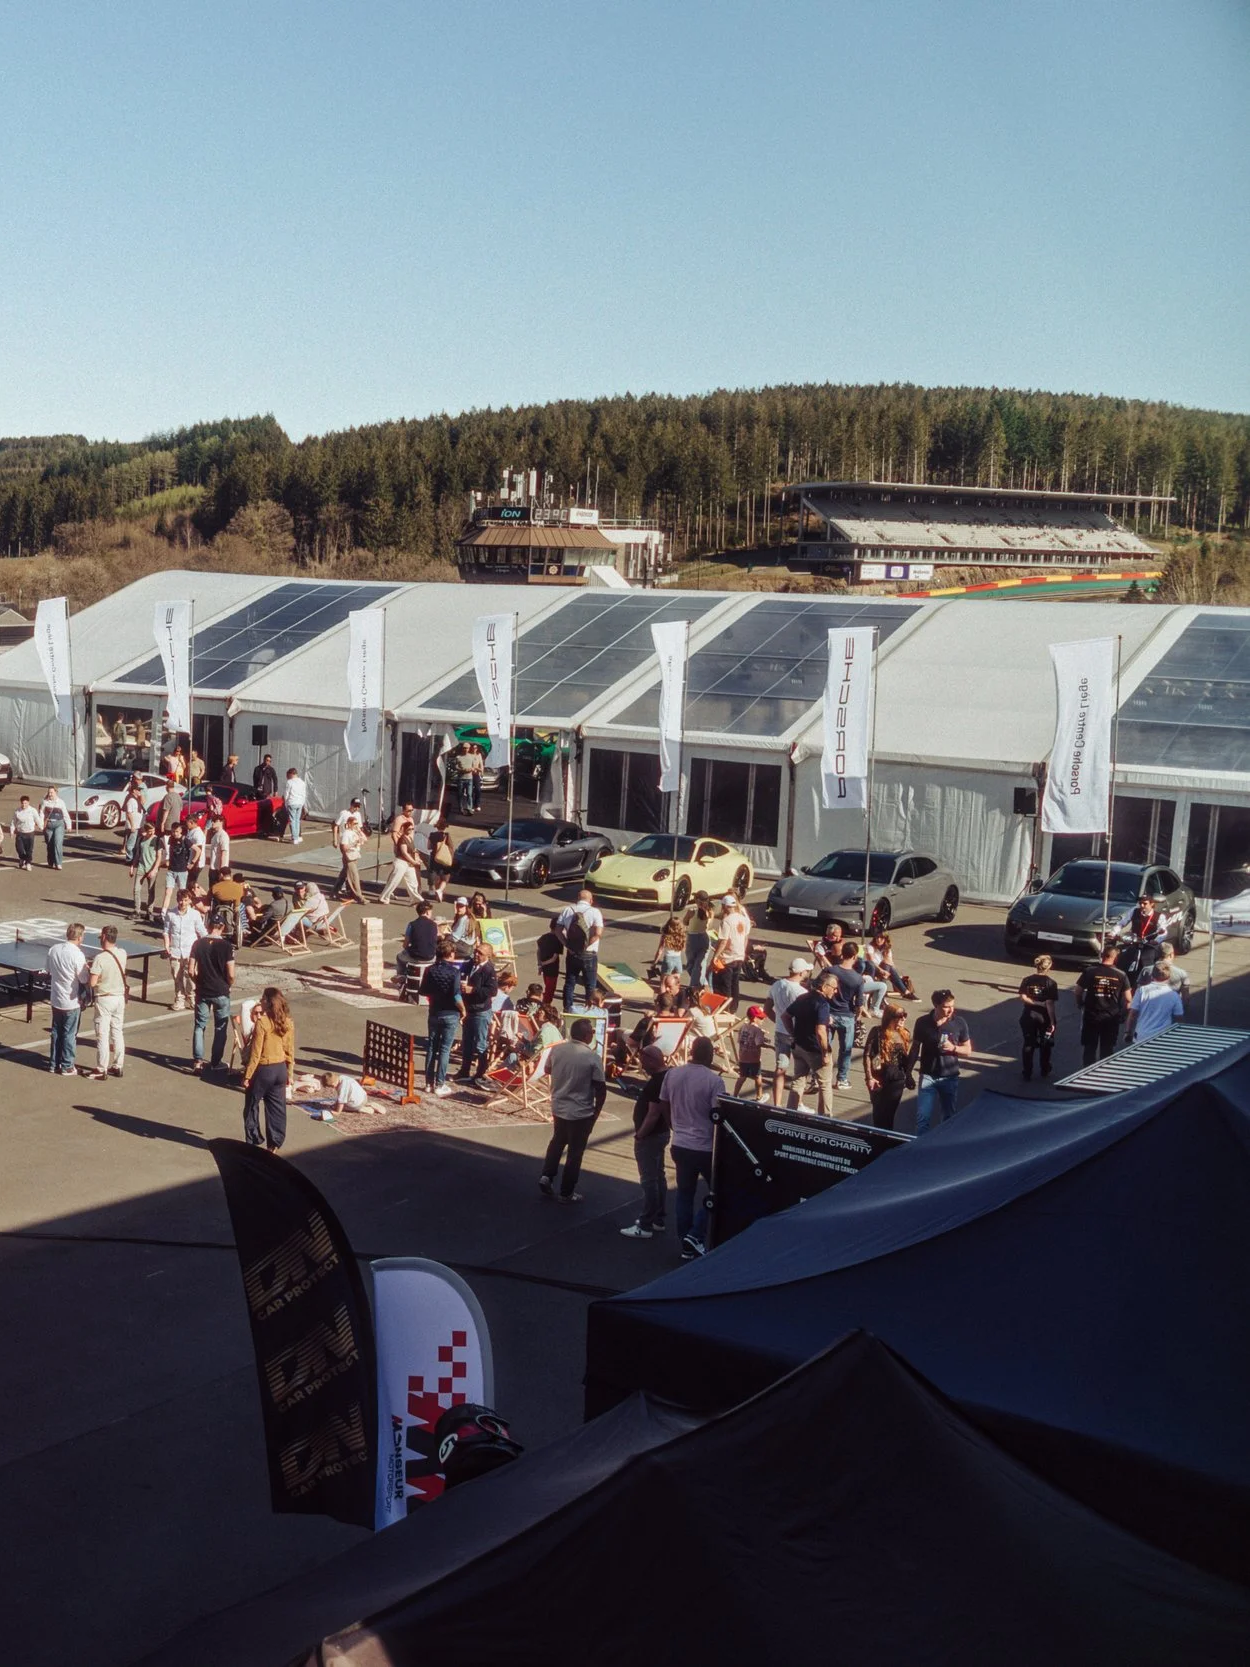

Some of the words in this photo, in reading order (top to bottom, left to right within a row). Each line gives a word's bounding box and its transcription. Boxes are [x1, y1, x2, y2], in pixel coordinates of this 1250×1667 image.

[773, 1149, 789, 1158] SPORT
[817, 1159, 835, 1170] CONTRE
[778, 1127, 807, 1140] DRIVE
[807, 1134, 828, 1145] FOR
[829, 1139, 873, 1155] CHARITY
[257, 1297, 285, 1321] CAR
[284, 1252, 340, 1302] PROTECT
[278, 1389, 305, 1414] CAR
[305, 1348, 360, 1396] PROTECT
[385, 1453, 395, 1515] MOTORSPORT
